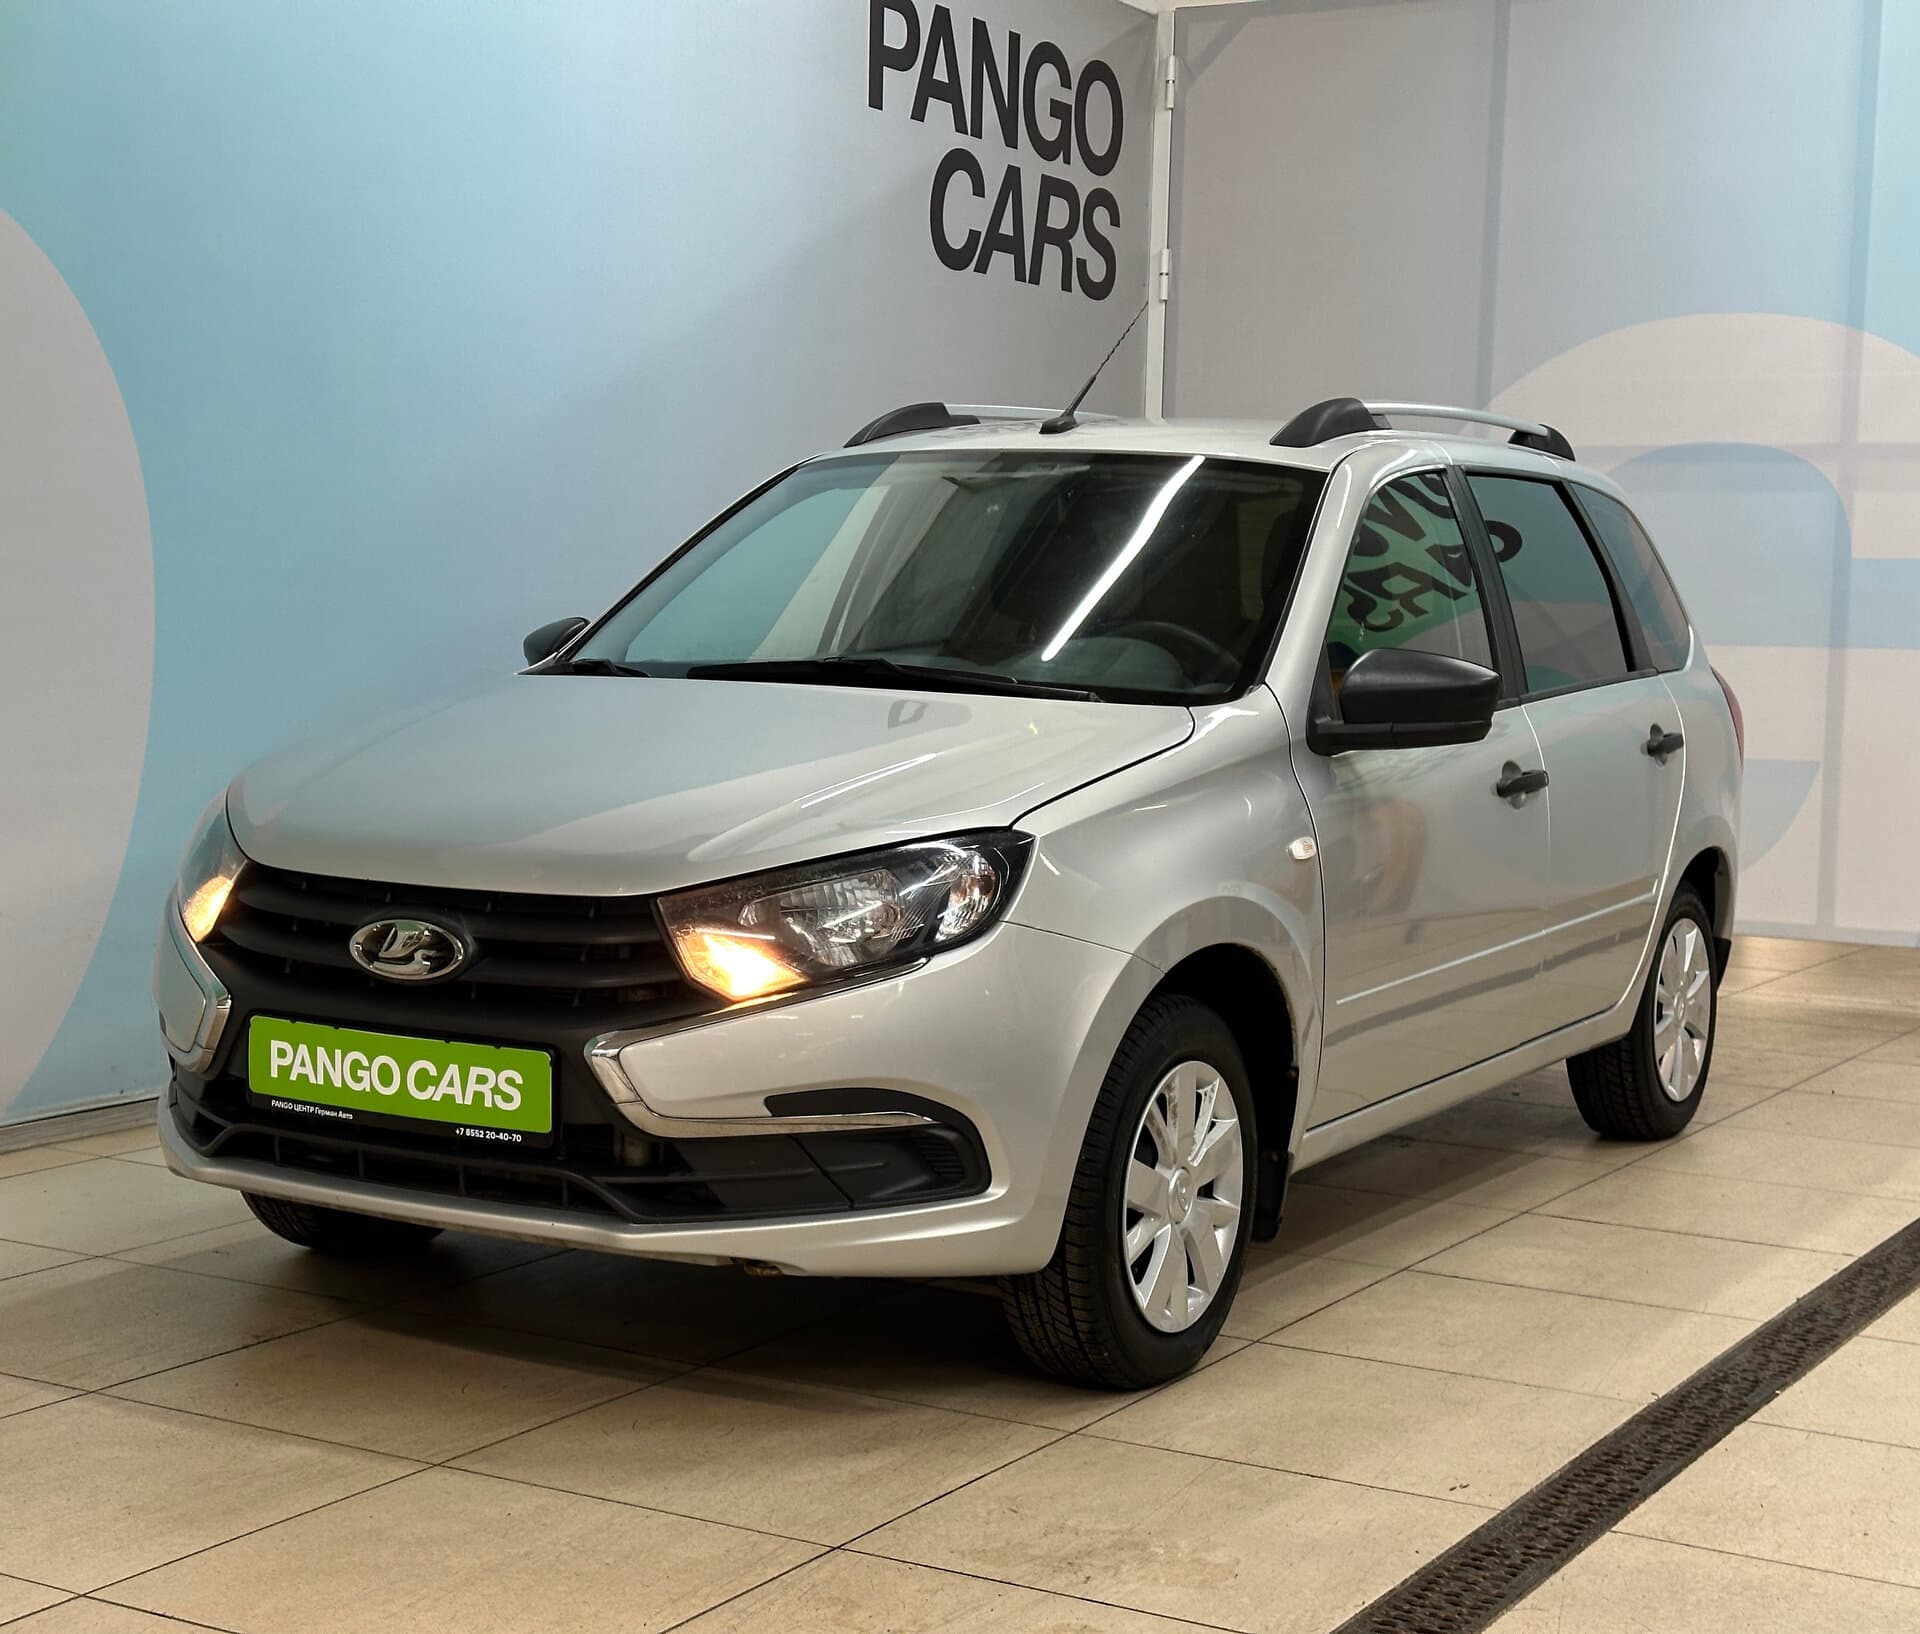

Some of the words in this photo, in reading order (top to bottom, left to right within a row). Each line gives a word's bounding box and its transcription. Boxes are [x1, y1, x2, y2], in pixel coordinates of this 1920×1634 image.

[868, 0, 1123, 176] PANGO
[930, 148, 1120, 301] CARS
[270, 1039, 401, 1096] PANGO
[406, 1060, 524, 1111] CARS
[271, 1099, 294, 1110] PANGO
[293, 1103, 315, 1113] ЦЕНТР
[455, 1127, 465, 1136] +7
[465, 1128, 484, 1138] 8552
[485, 1130, 522, 1143] 20-40-70
